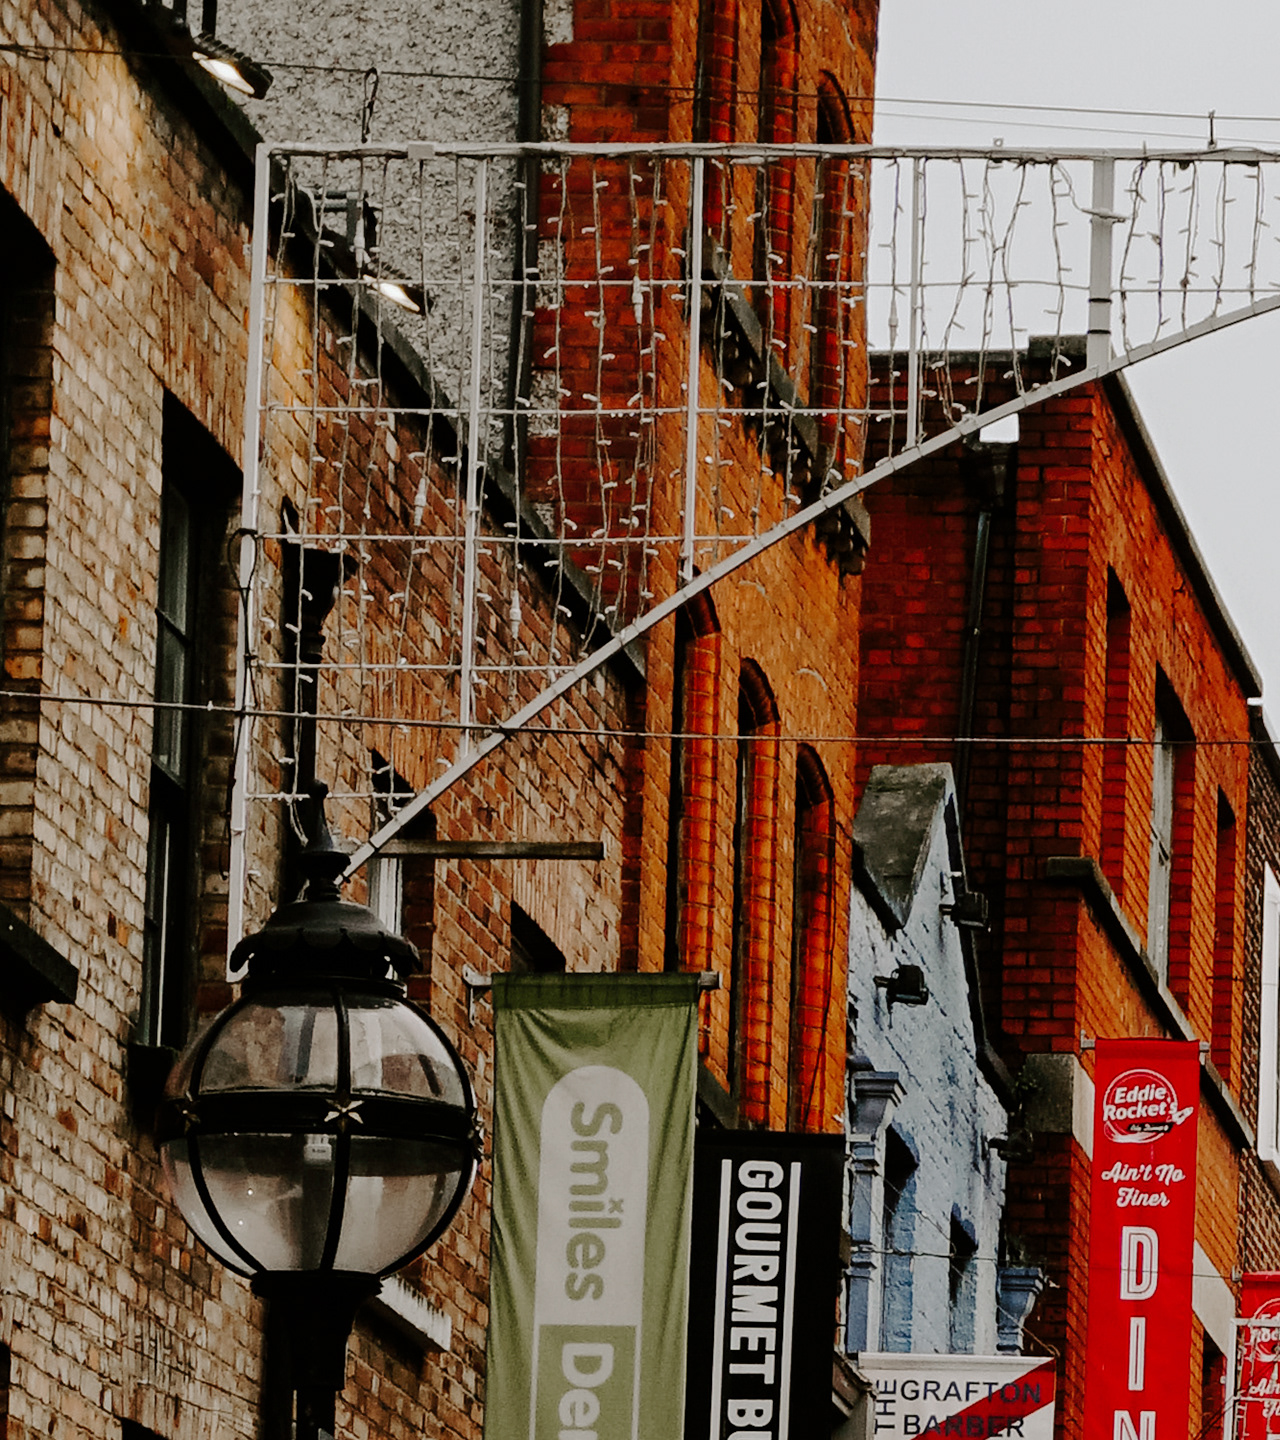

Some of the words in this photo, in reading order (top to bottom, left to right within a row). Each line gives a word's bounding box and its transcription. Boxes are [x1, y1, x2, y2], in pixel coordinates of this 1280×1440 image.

[1114, 1083, 1167, 1104] Eddie
[1103, 1096, 1178, 1121] Rocket's
[1101, 1161, 1152, 1183] Ain't
[1155, 1163, 1186, 1186] No
[565, 1100, 625, 1302] Smiles
[1116, 1186, 1170, 1207] Finer
[728, 1159, 785, 1385] GOURMET
[874, 1378, 897, 1432] THE
[900, 1379, 1042, 1404] GRAFTON
[903, 1414, 1025, 1439] BARBER
